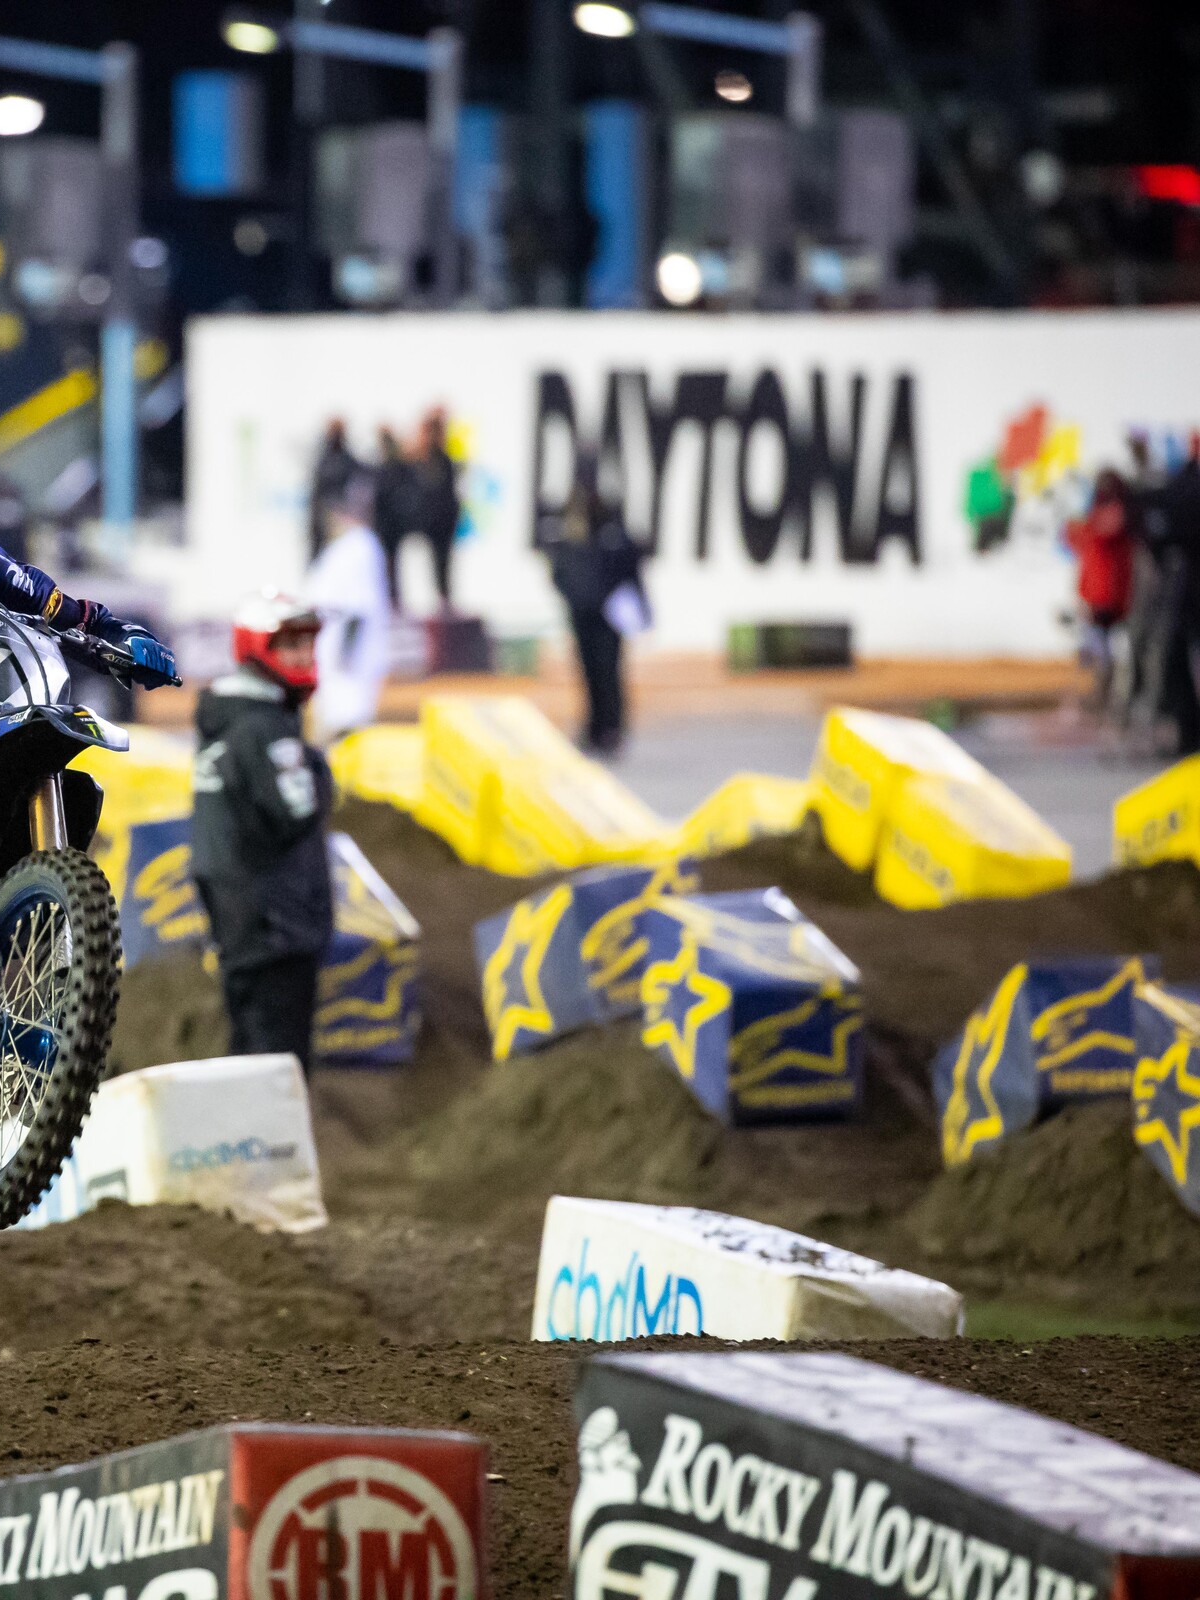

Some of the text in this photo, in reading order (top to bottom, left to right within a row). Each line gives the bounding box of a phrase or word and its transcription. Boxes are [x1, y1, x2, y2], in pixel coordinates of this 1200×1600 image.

[531, 367, 922, 566] DAYTONA
[27, 1470, 224, 1575] MOUNTAIN
[642, 1414, 820, 1552] ROCKY
